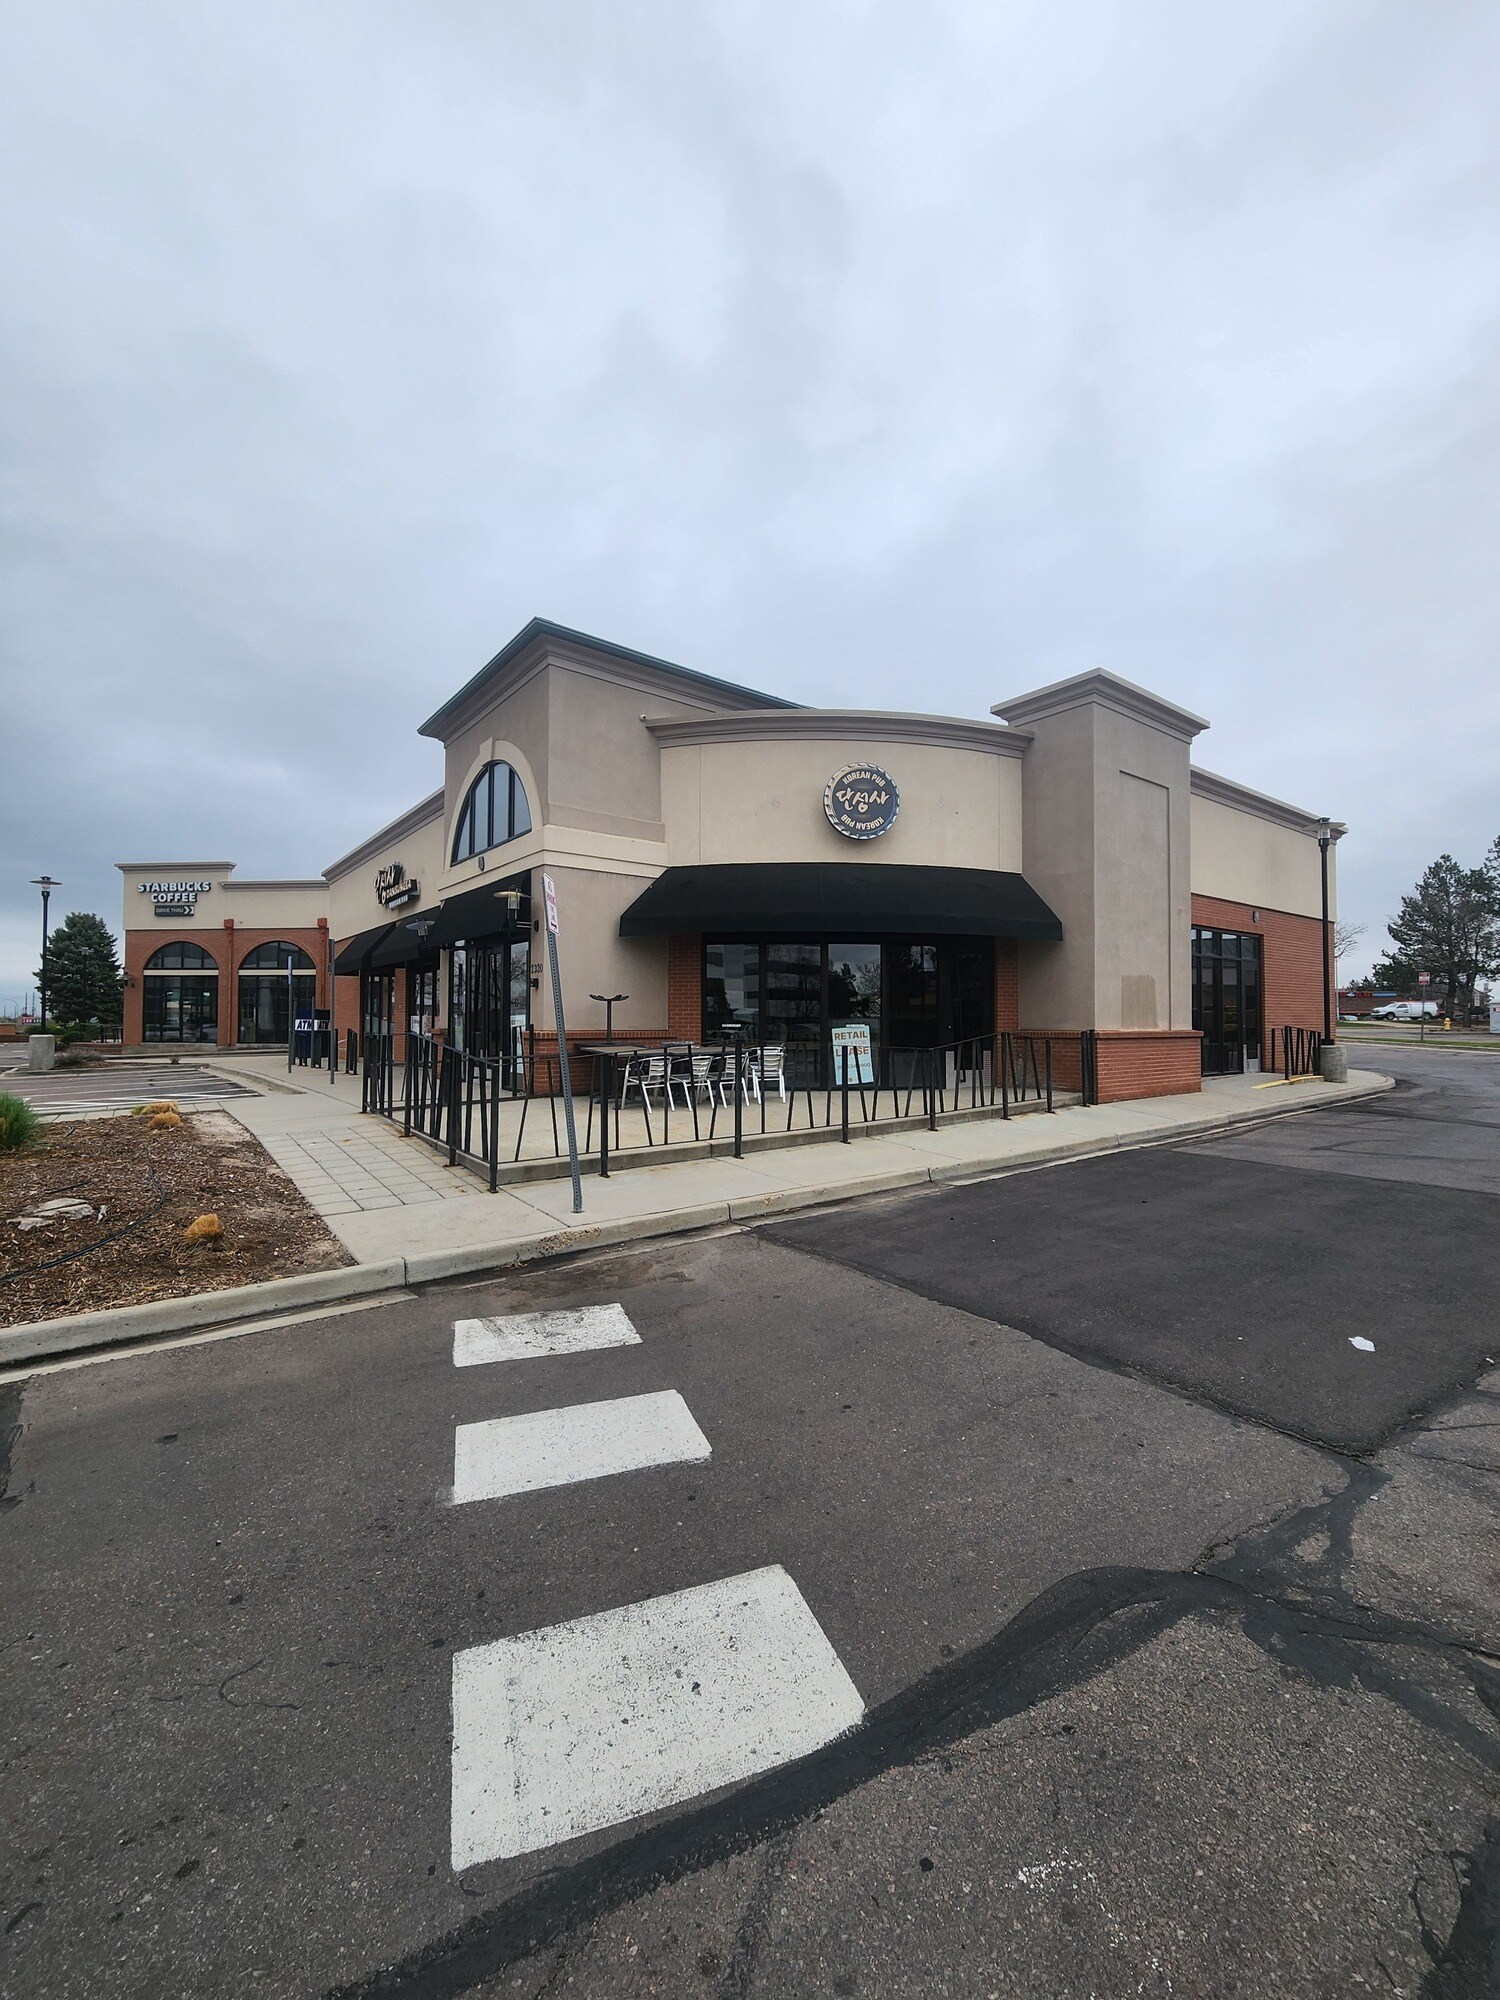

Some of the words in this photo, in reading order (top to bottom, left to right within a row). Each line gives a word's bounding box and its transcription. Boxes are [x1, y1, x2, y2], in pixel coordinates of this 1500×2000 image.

[842, 771, 871, 785] KOREAN
[871, 775, 886, 788] PUB
[835, 787, 890, 813] 단성사
[840, 814, 855, 828] PUB
[855, 816, 885, 830] KOREAN
[137, 881, 211, 893] STARBUCKS
[151, 892, 197, 903] COFFEE
[296, 1019, 313, 1030] ATM
[834, 1030, 868, 1041] RETAIL
[835, 1046, 870, 1058] LASE
